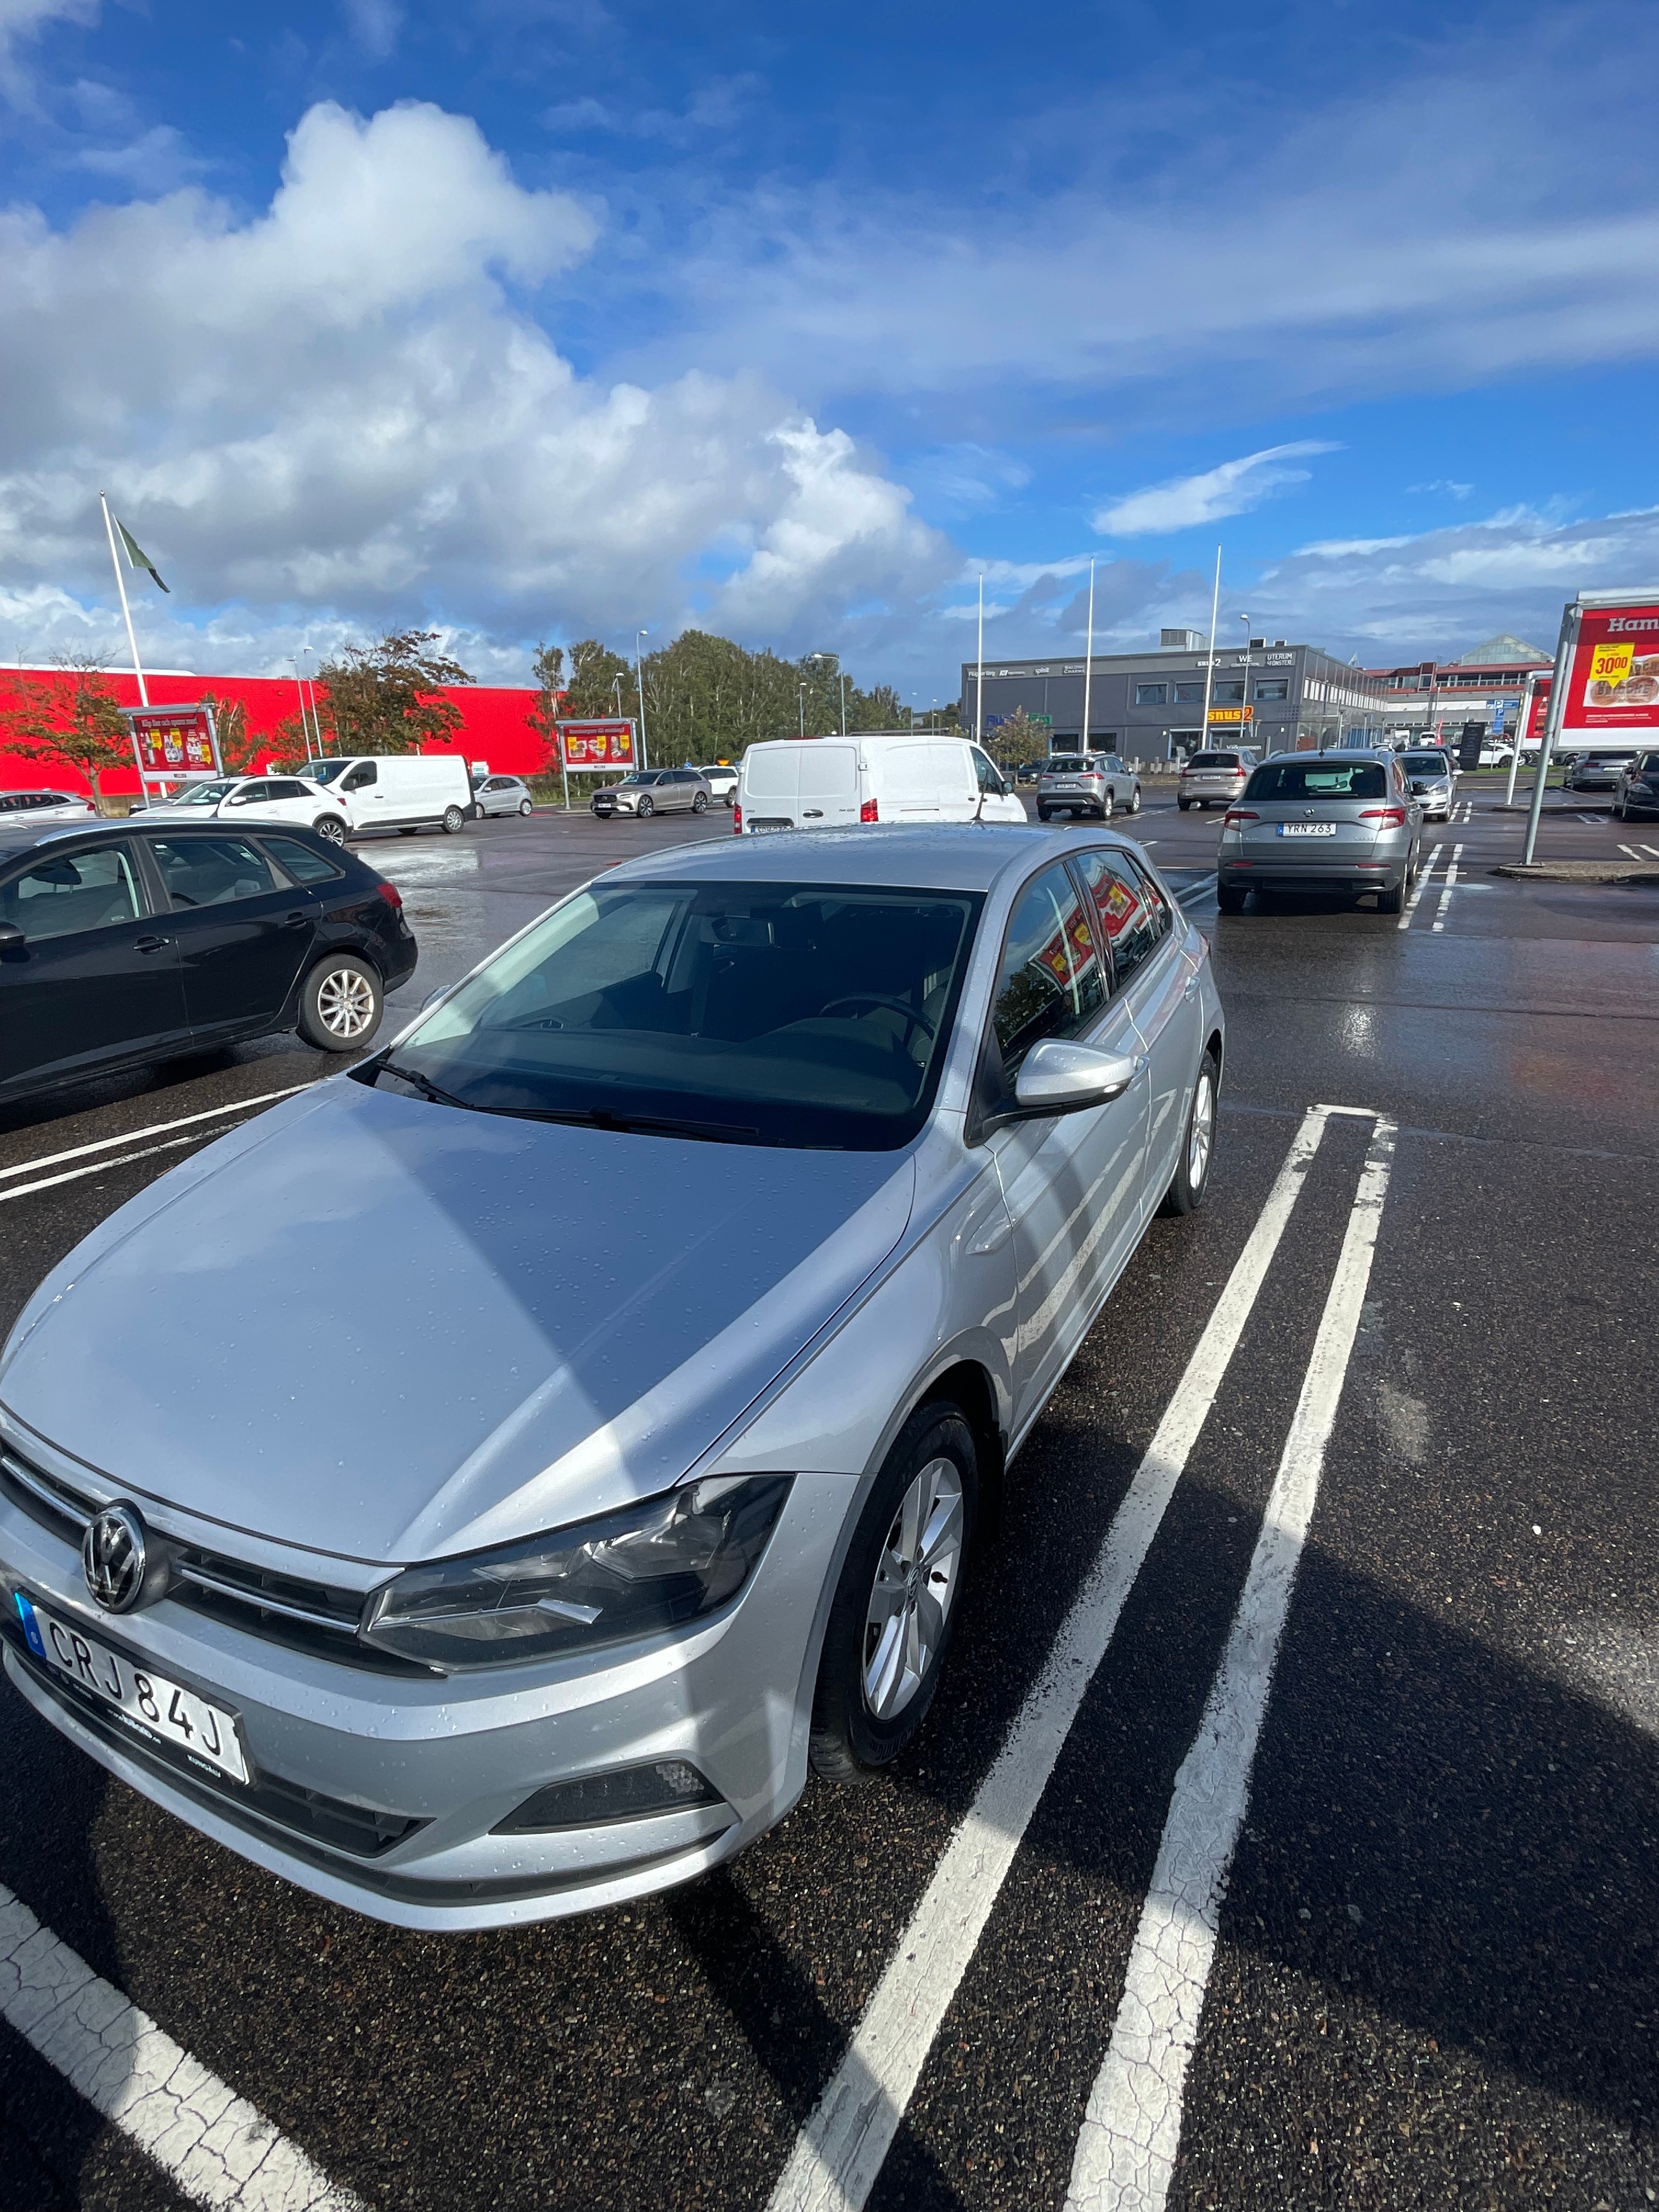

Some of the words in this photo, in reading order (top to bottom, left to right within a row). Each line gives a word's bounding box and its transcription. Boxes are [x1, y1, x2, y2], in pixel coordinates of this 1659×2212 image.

[1288, 825, 1307, 833] YRN
[1311, 824, 1331, 833] 263
[50, 1622, 123, 1699] CRJ
[134, 1673, 222, 1756] 84J
